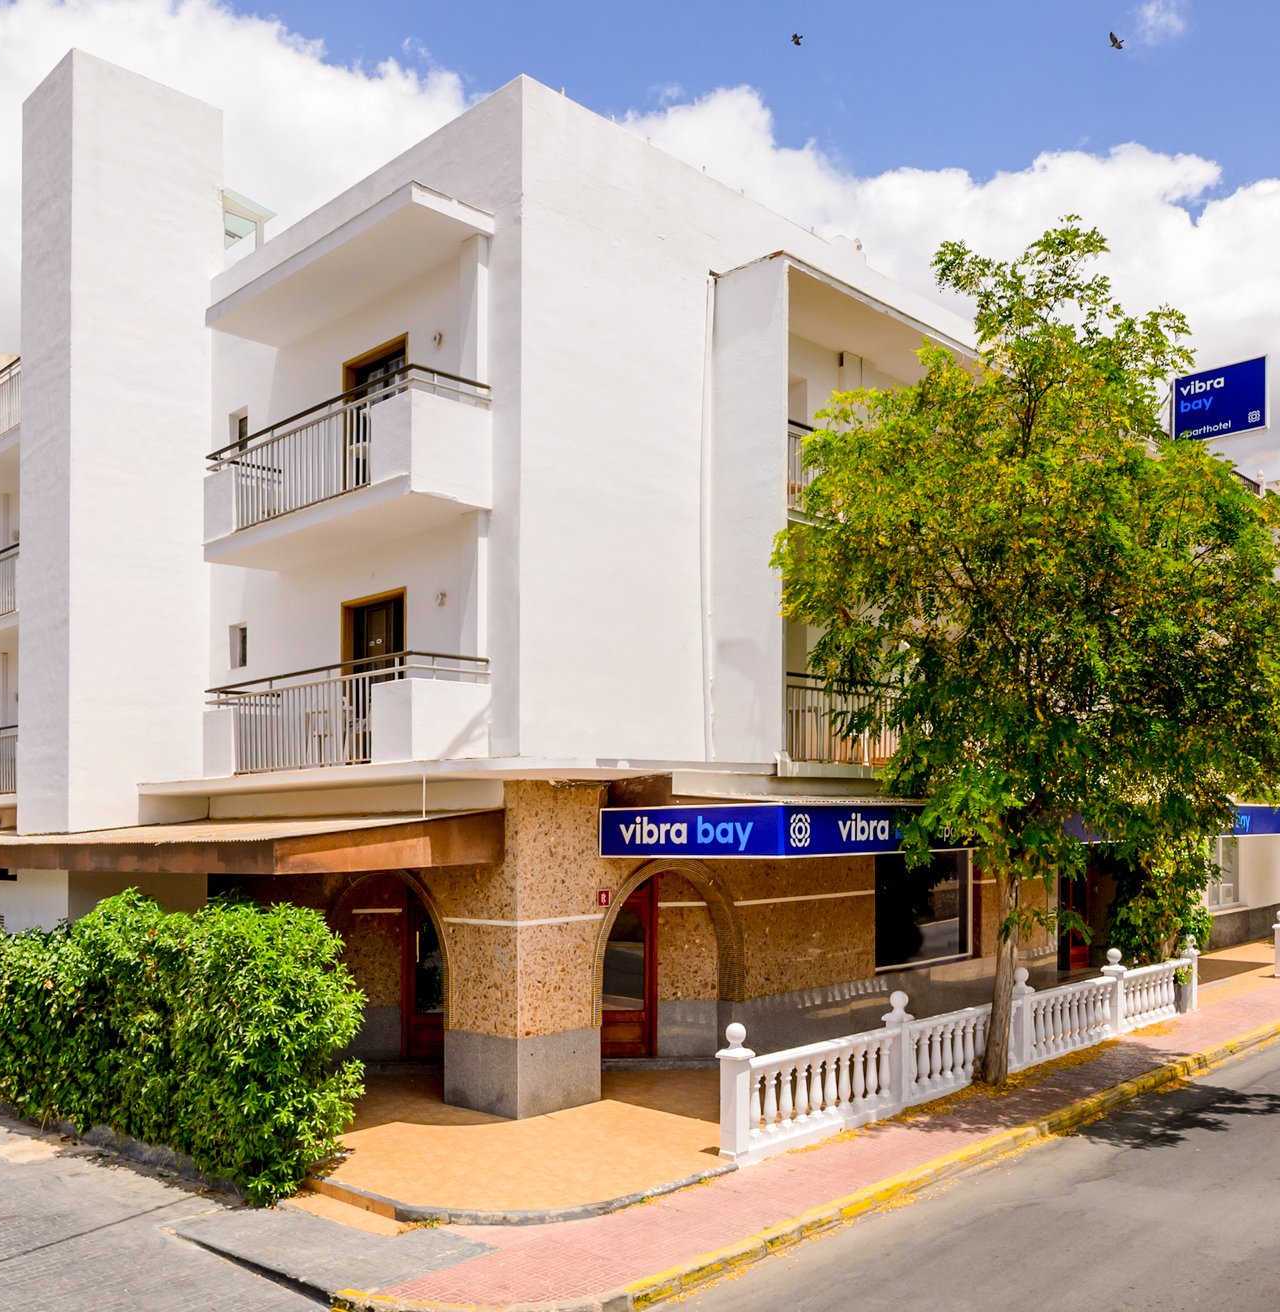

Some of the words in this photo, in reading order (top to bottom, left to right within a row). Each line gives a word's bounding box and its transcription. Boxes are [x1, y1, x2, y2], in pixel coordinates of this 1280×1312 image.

[1180, 377, 1225, 396] vibra
[1180, 396, 1214, 413] bay
[619, 816, 688, 845] vibra
[696, 815, 754, 851] bay
[838, 812, 890, 842] vibra
